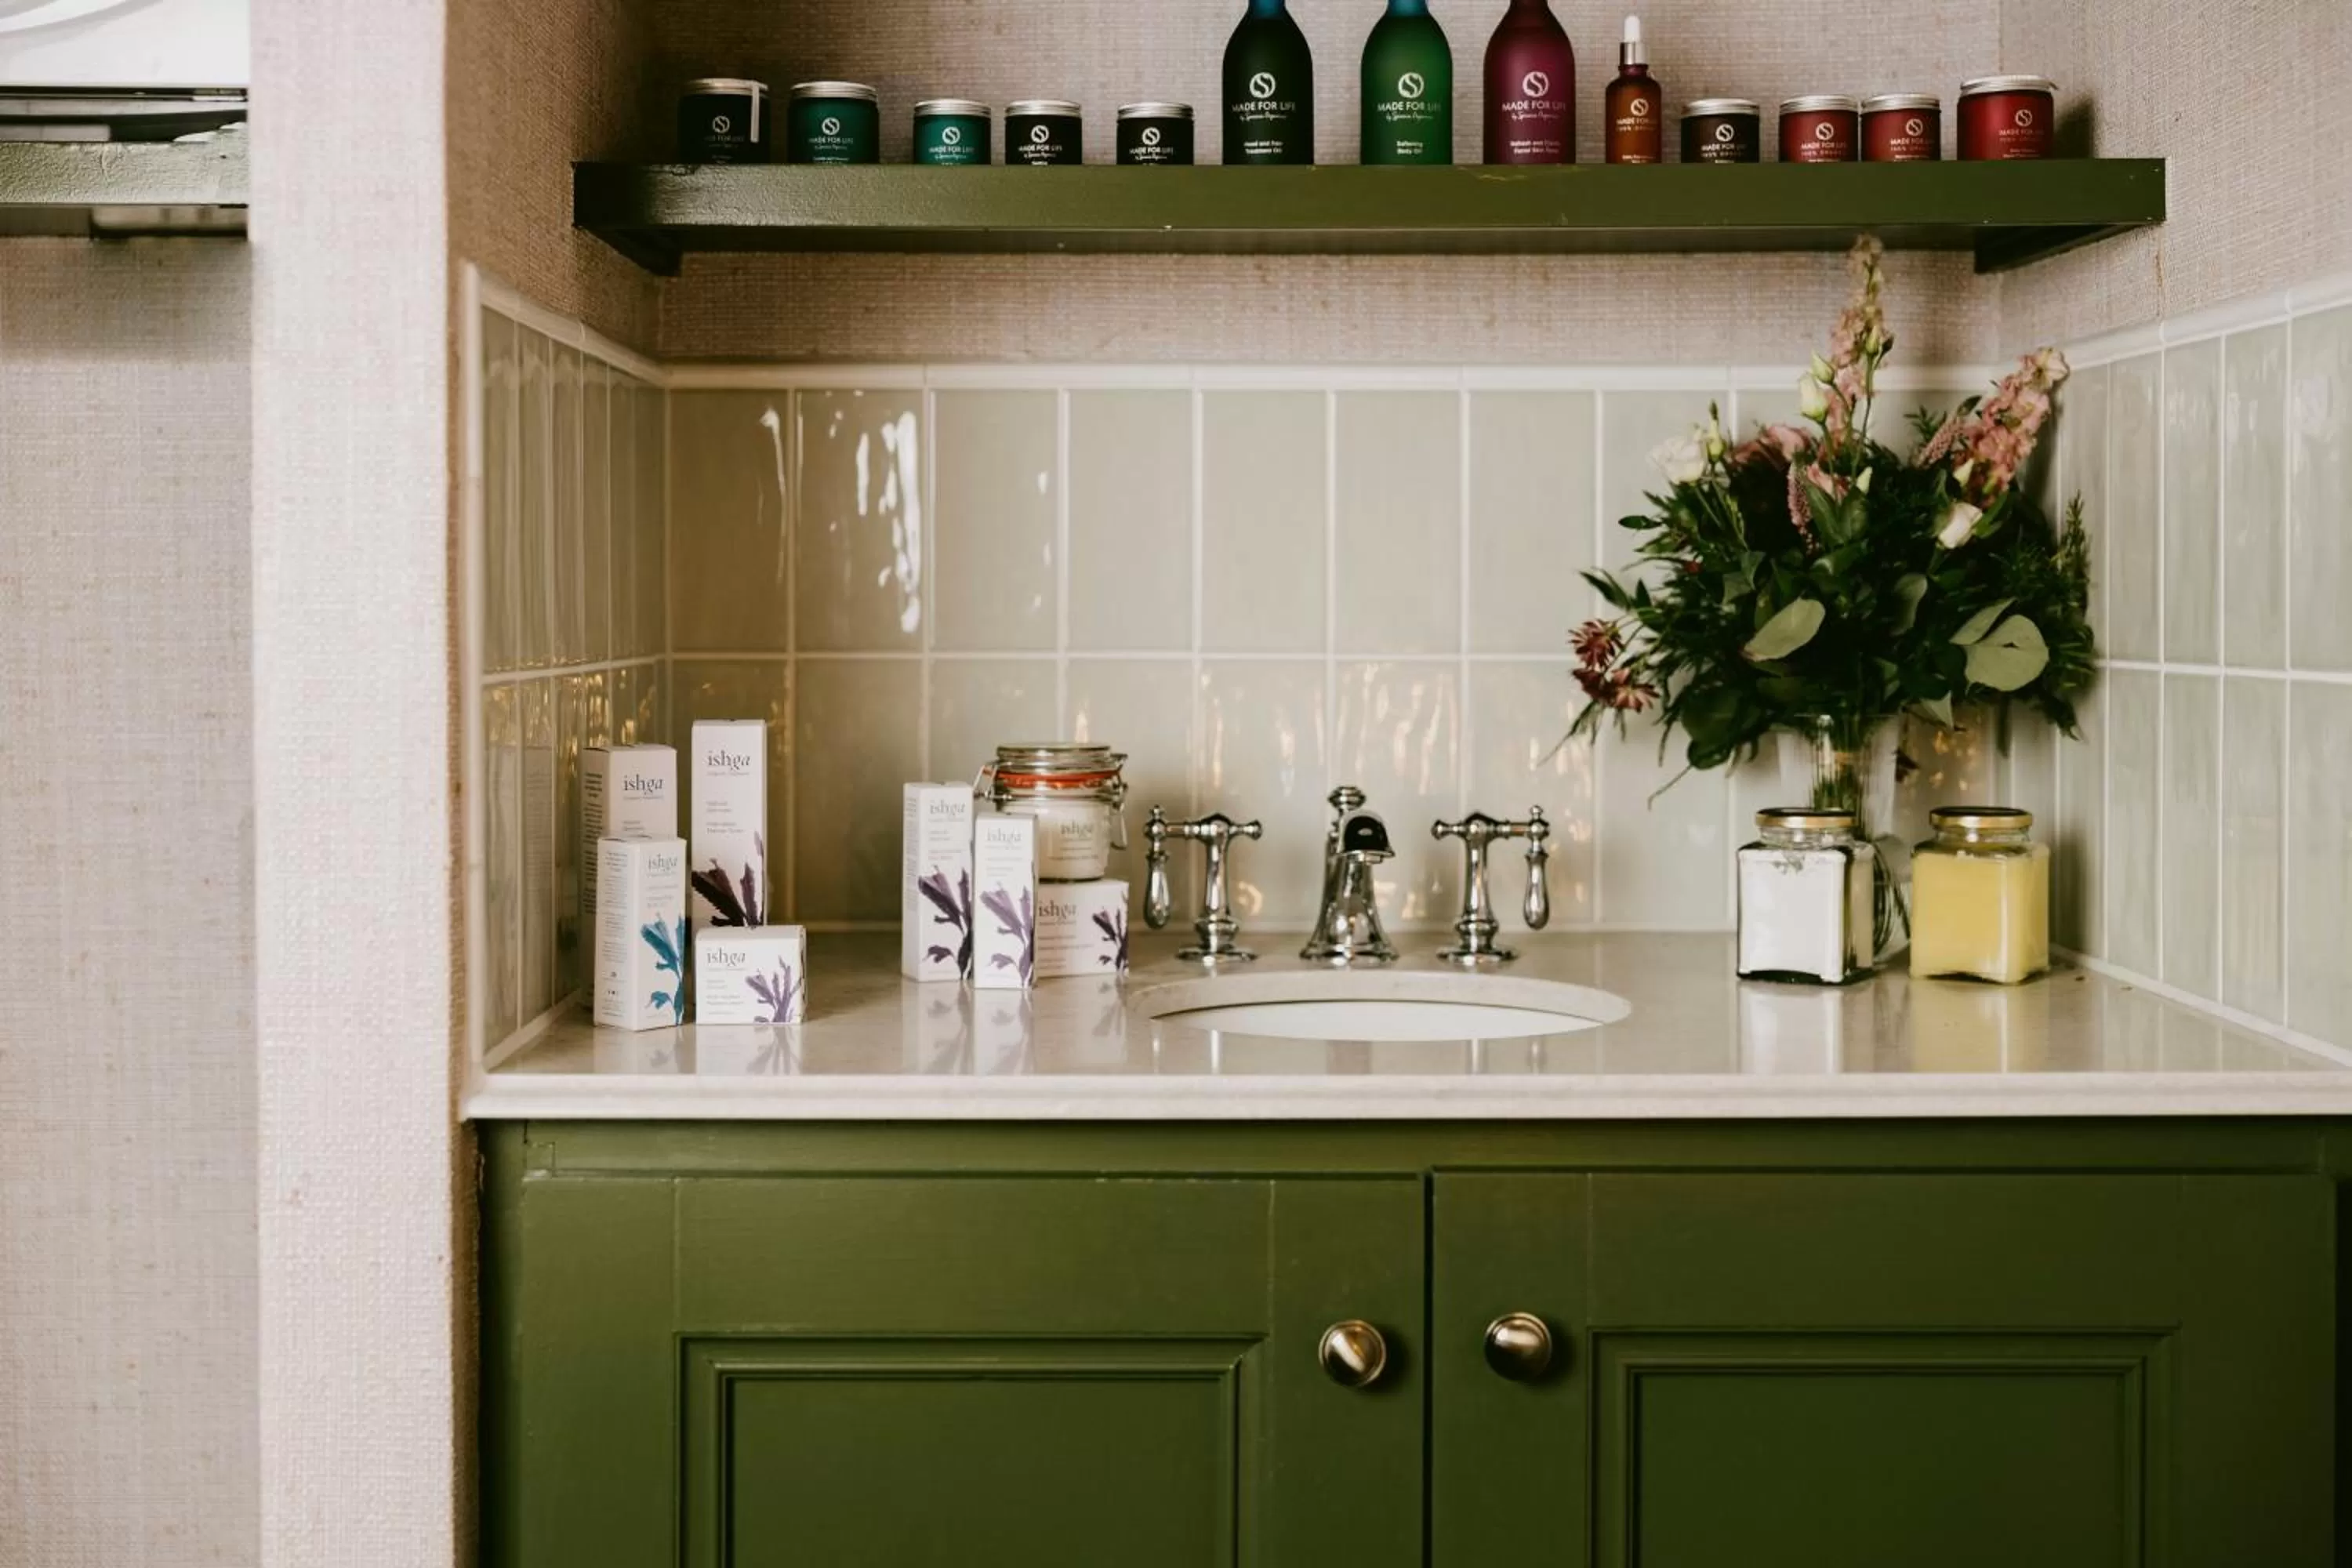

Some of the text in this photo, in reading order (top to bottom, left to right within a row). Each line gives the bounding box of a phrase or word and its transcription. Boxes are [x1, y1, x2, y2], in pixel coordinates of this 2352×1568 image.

[1232, 101, 1295, 111] MADE FOR LIFE
[1377, 102, 1403, 111] MADE
[1406, 101, 1425, 111] FOR
[1502, 100, 1529, 111] MADE
[1531, 100, 1551, 110] FOR
[707, 750, 750, 770] ishga
[623, 774, 663, 794] ishga
[929, 799, 966, 816] ishga
[1039, 899, 1076, 920] ishga
[706, 947, 746, 967] ishga
